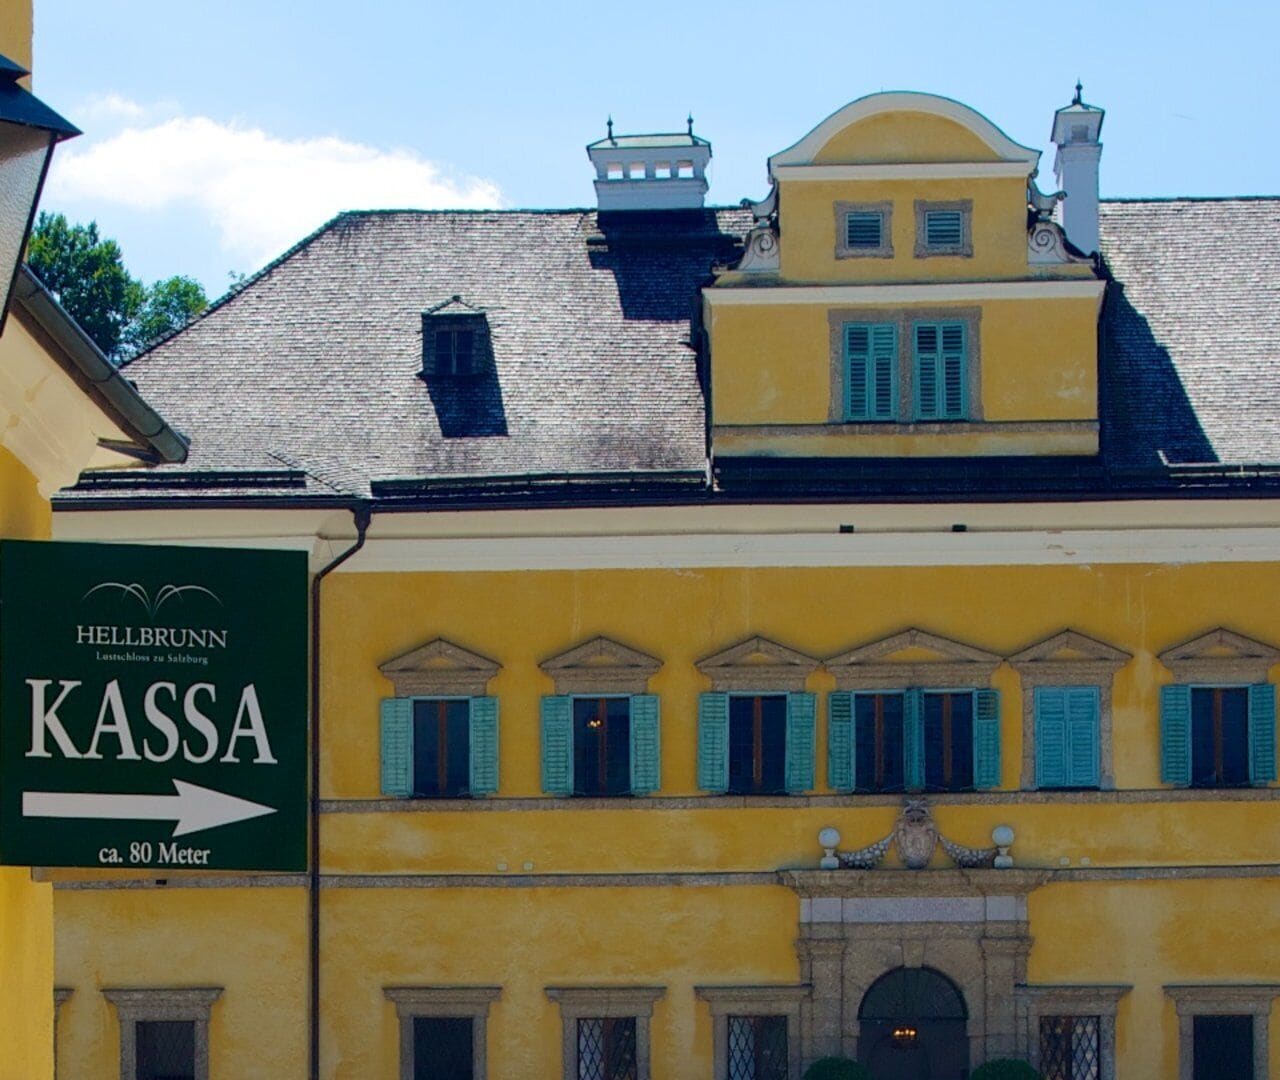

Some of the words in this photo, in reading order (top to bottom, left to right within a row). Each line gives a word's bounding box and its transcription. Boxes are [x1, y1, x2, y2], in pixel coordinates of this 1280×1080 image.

[76, 625, 228, 648] HELLBRUNN
[96, 651, 150, 662] Lustschloss
[153, 655, 165, 663] zu
[168, 653, 209, 665] Salzburg
[25, 678, 278, 764] KASSA
[98, 847, 123, 863] ca.
[129, 842, 152, 863] 80
[157, 842, 211, 864] Meter
